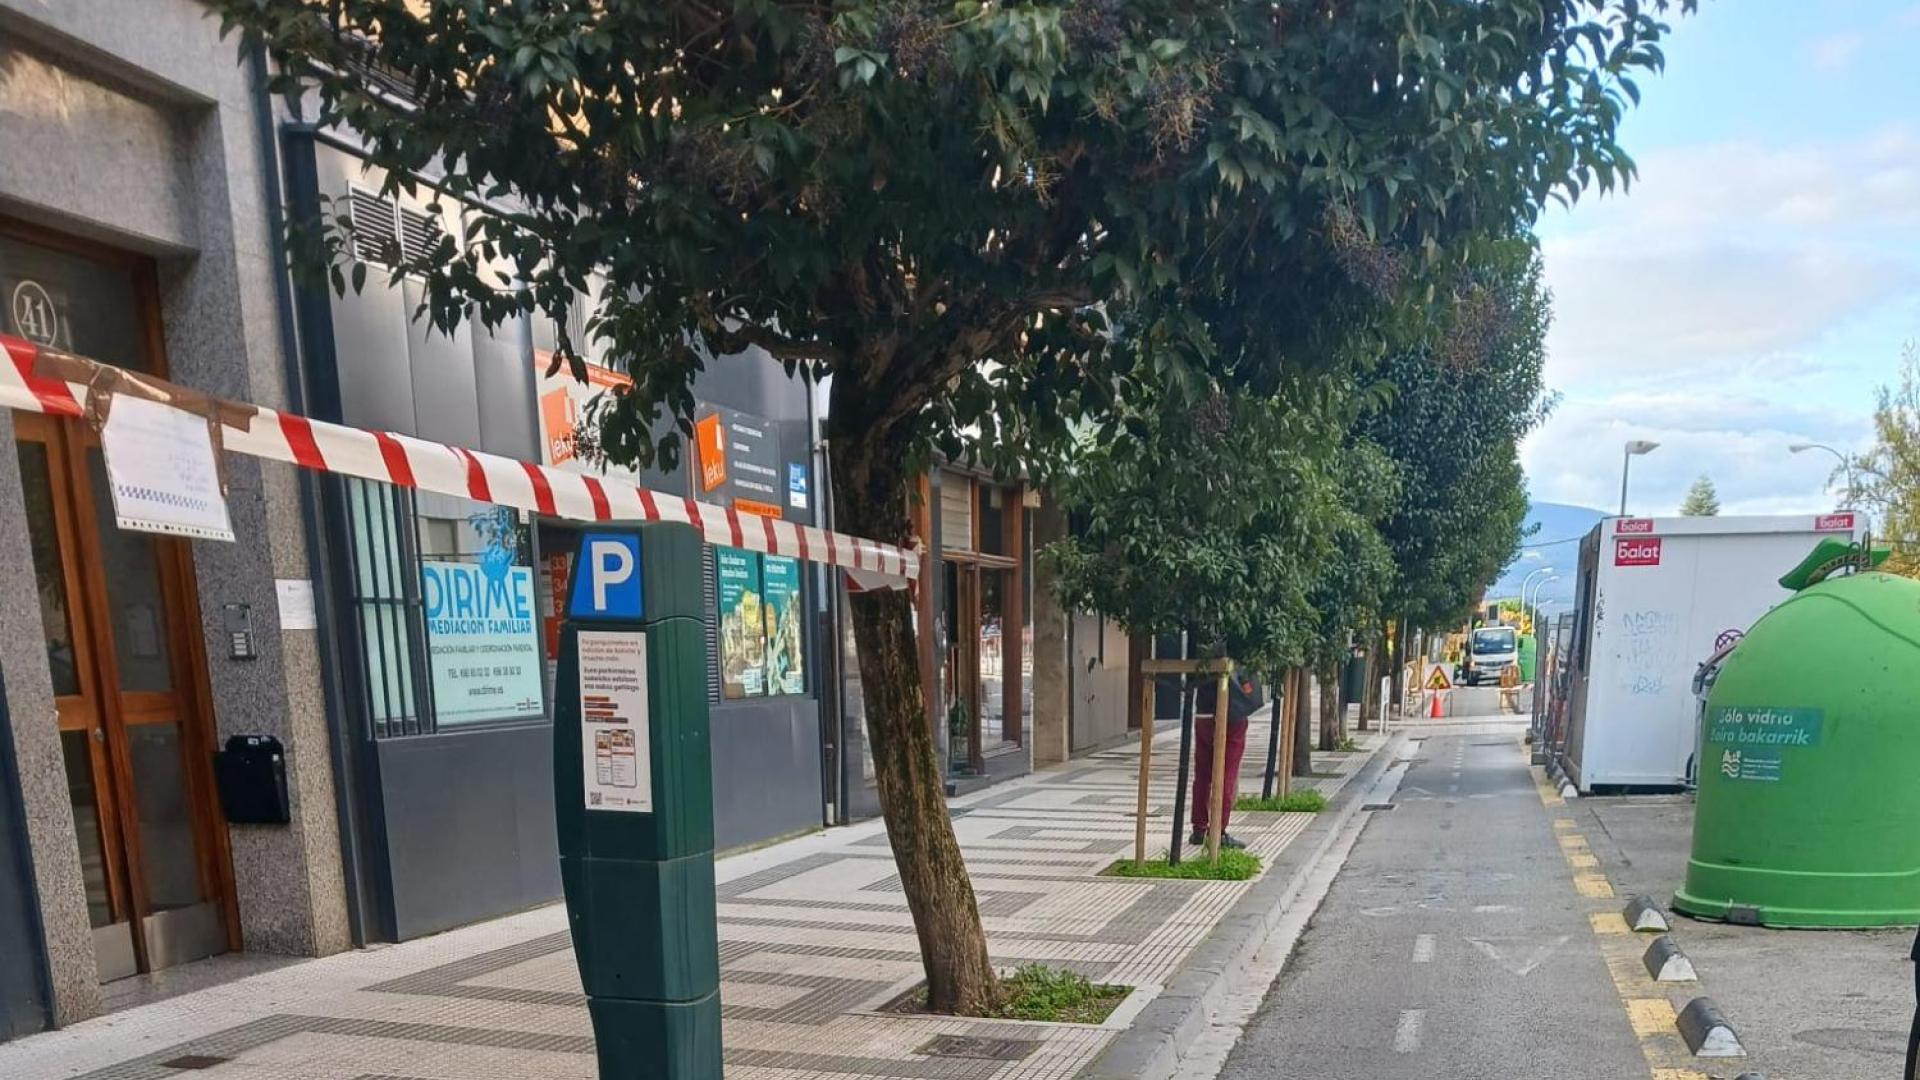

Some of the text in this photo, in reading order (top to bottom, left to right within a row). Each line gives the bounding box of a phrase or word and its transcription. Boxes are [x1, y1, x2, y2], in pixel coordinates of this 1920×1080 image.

[21, 295, 51, 337] 41
[703, 459, 724, 486] leku
[1618, 541, 1659, 559] balat
[591, 541, 634, 610] P
[423, 567, 530, 618] DIRIME
[488, 620, 531, 634] FAMILIAR
[1738, 727, 1811, 745] bakarrik
